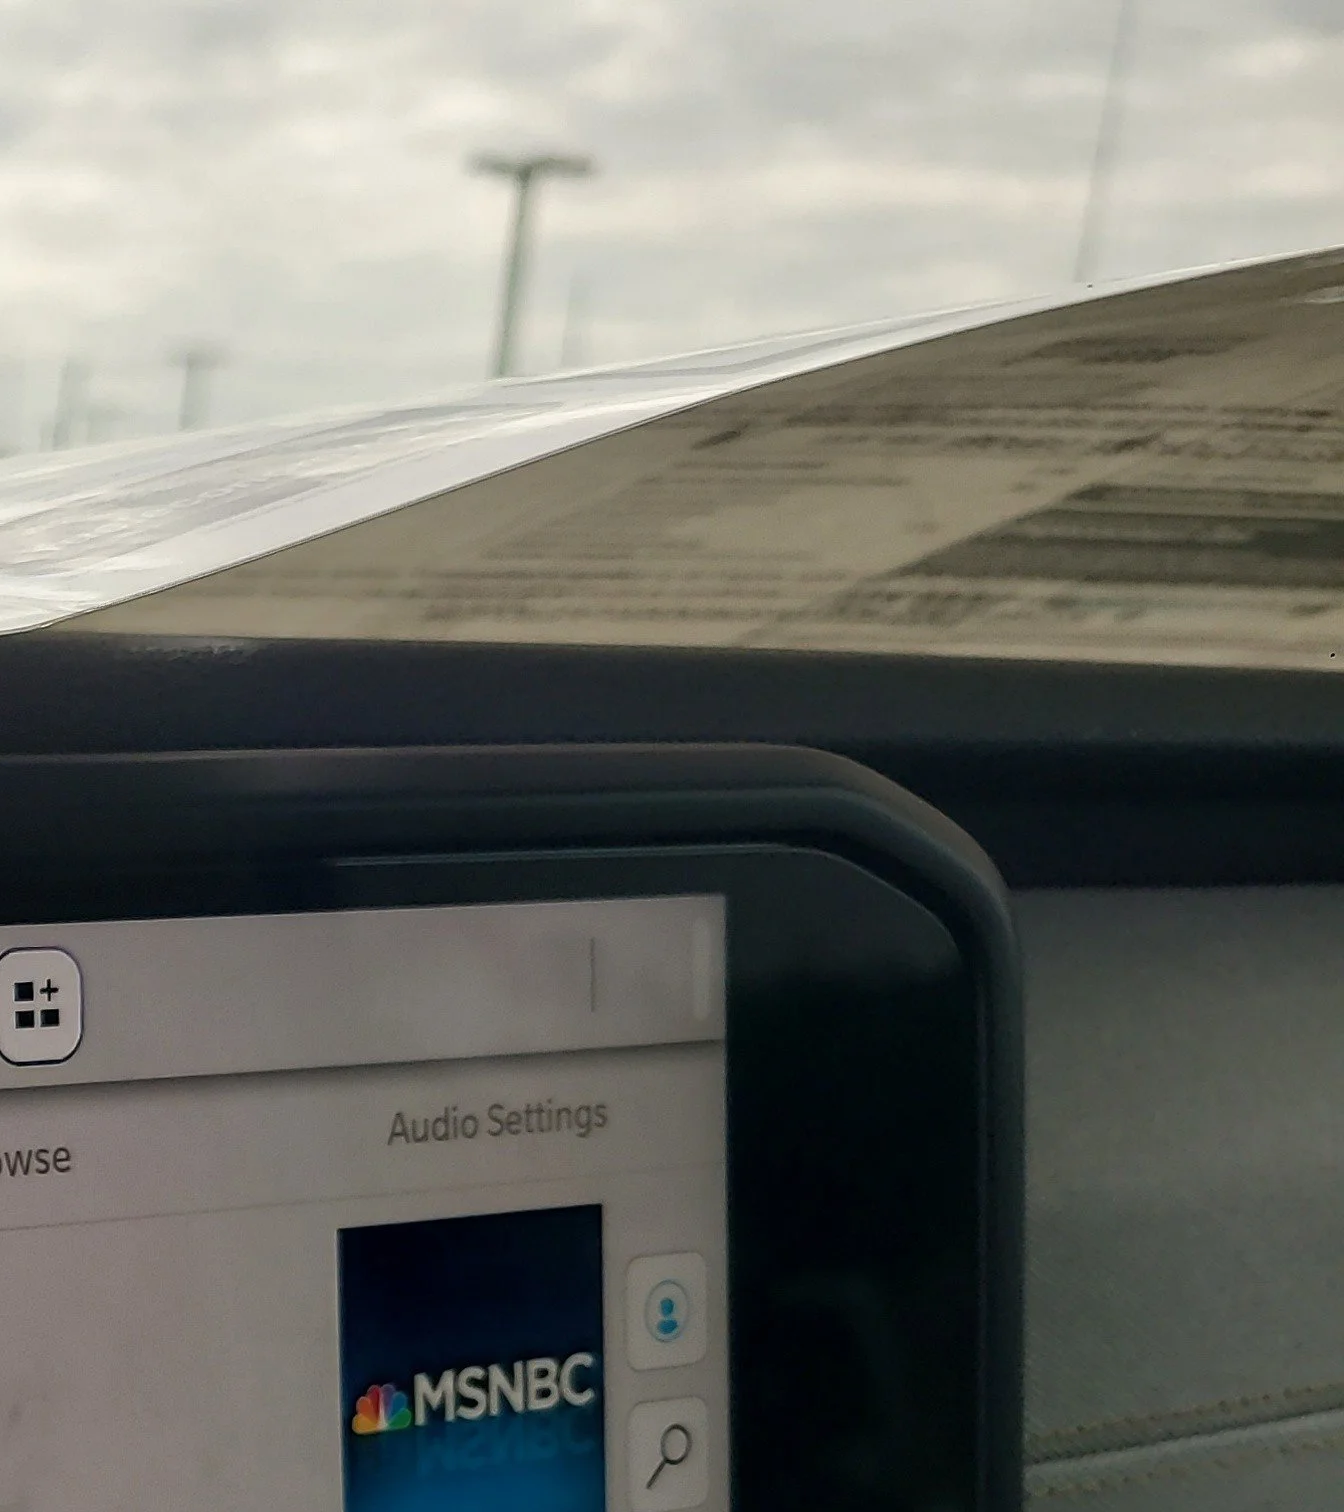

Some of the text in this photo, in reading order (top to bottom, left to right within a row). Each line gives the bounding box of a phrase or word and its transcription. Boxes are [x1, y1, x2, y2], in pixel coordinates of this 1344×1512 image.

[387, 1098, 608, 1146] Audio Settings
[413, 1350, 597, 1427] MSNBC
